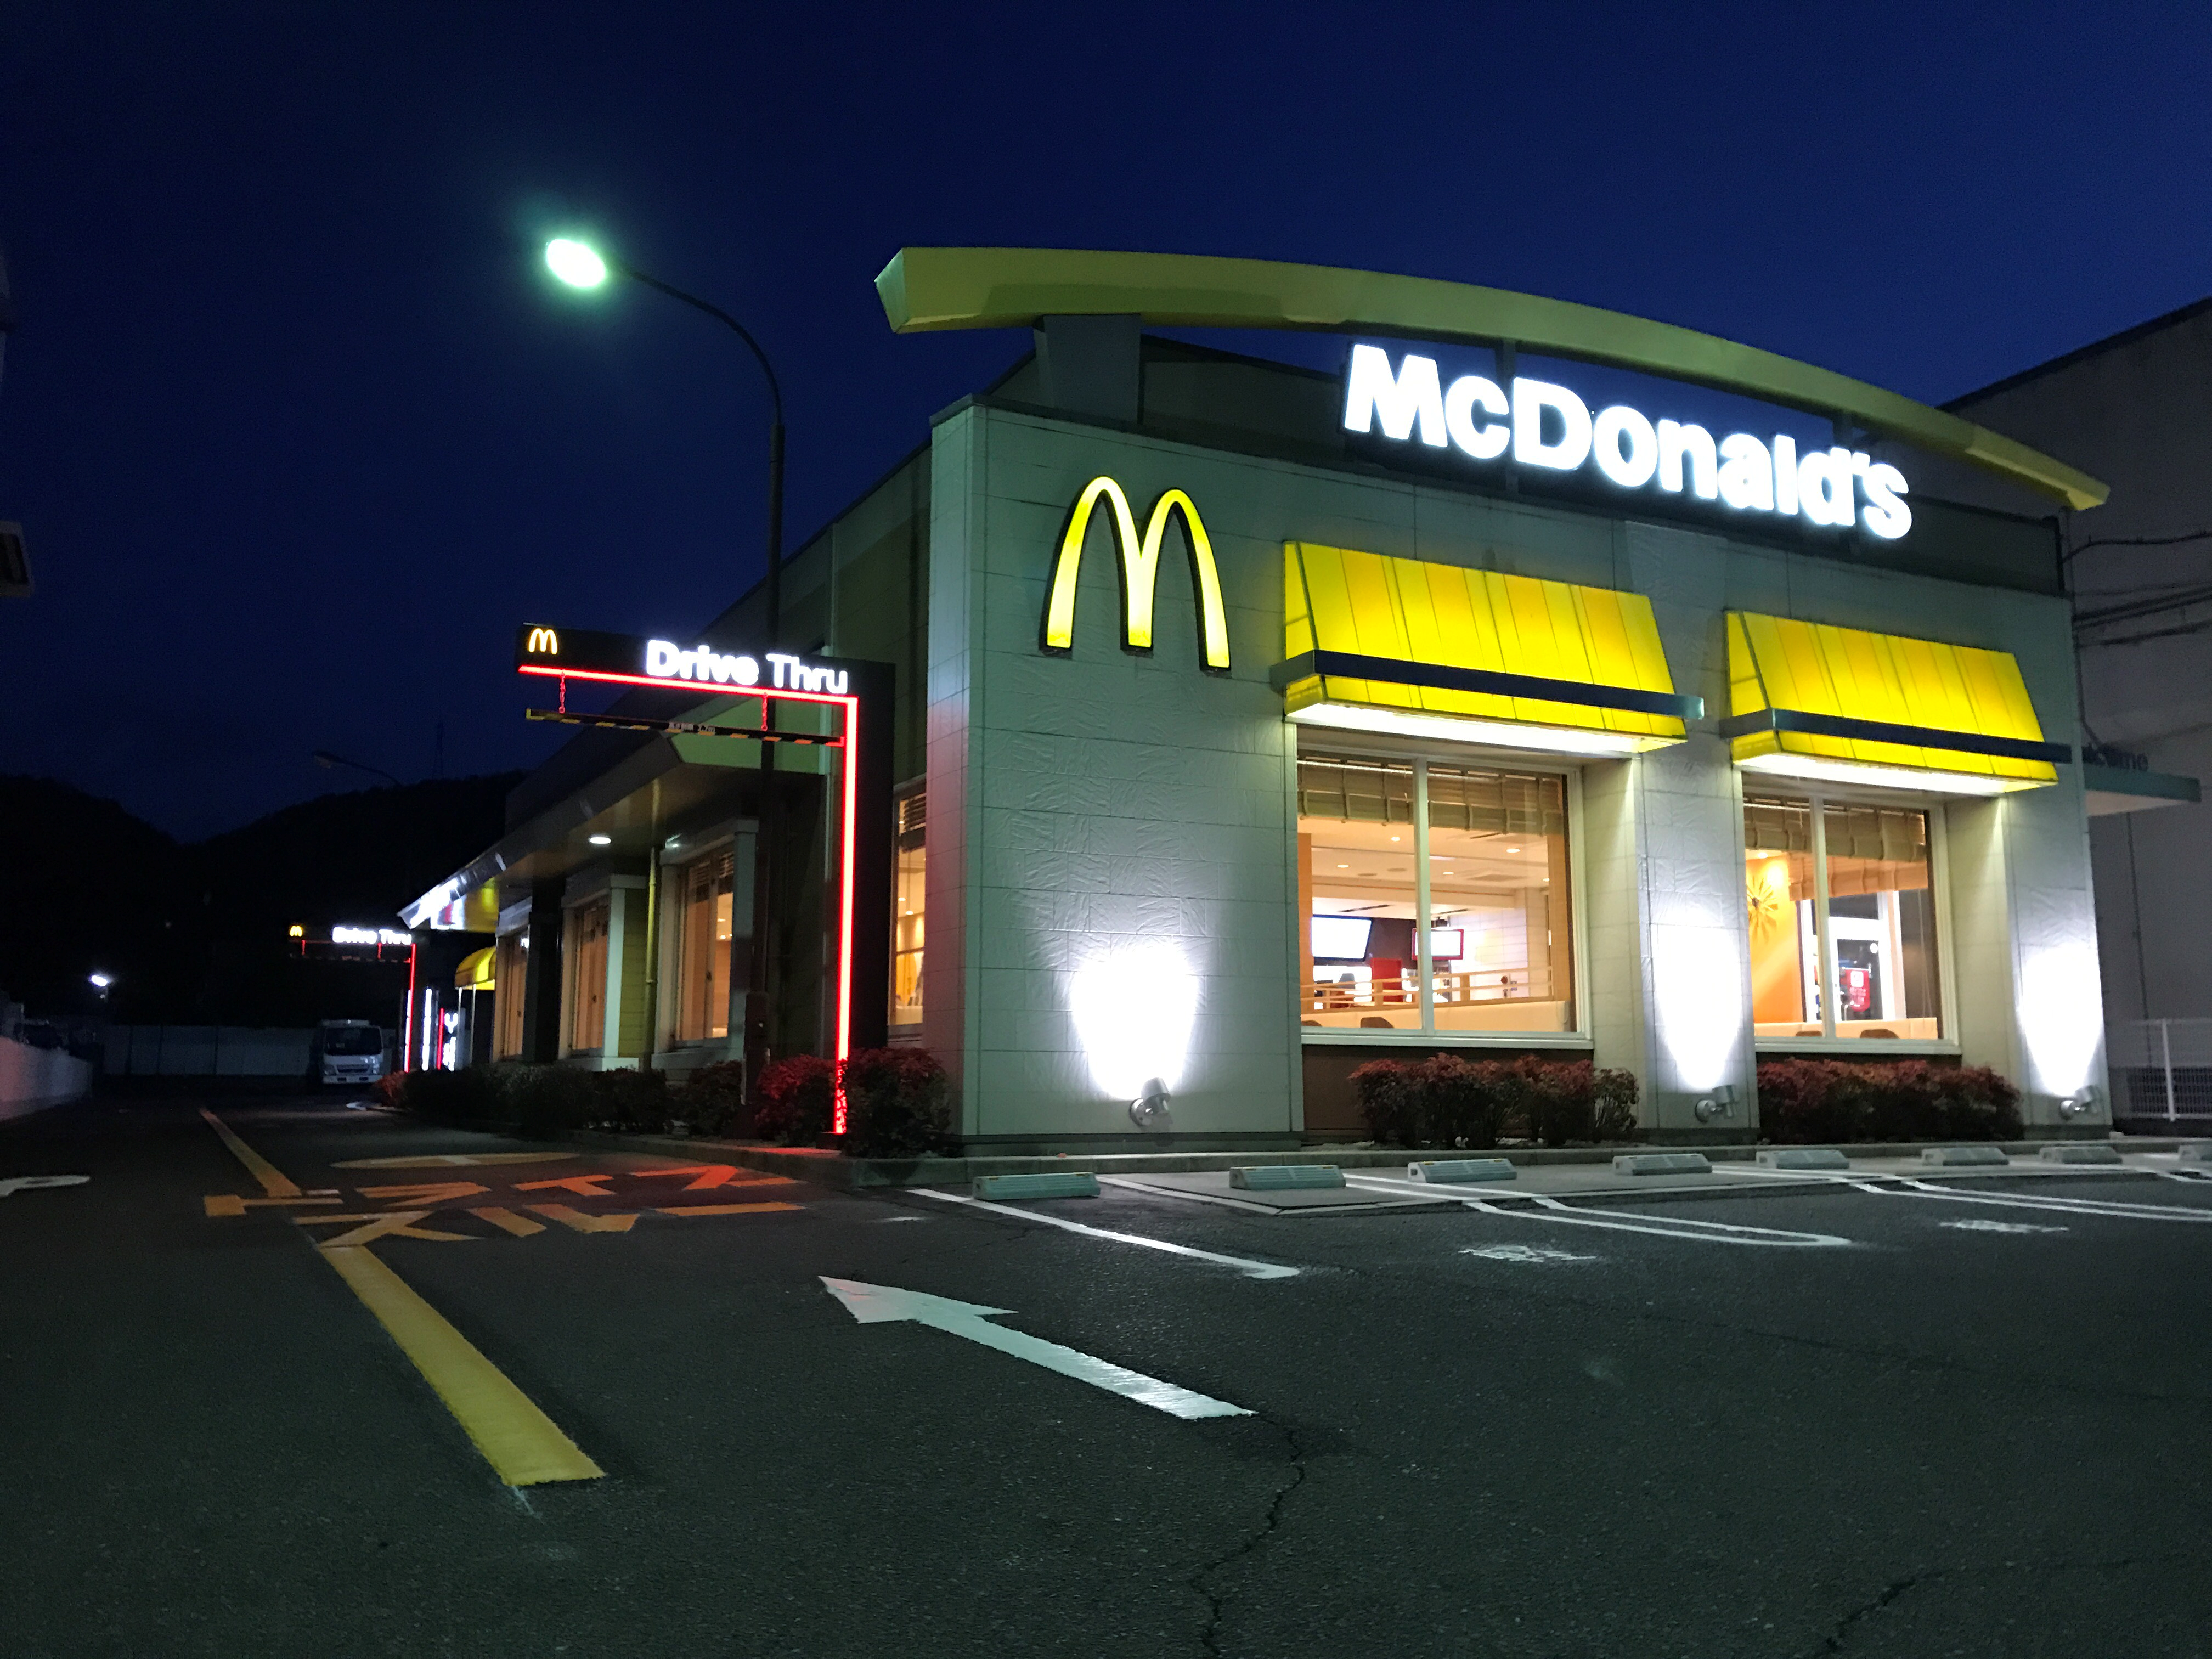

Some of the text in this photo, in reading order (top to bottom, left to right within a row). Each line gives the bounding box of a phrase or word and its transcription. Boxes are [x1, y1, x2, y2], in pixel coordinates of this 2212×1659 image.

[1344, 342, 1913, 540] McDonald's
[646, 639, 848, 694] Drive Thru
[1044, 475, 1231, 669] M
